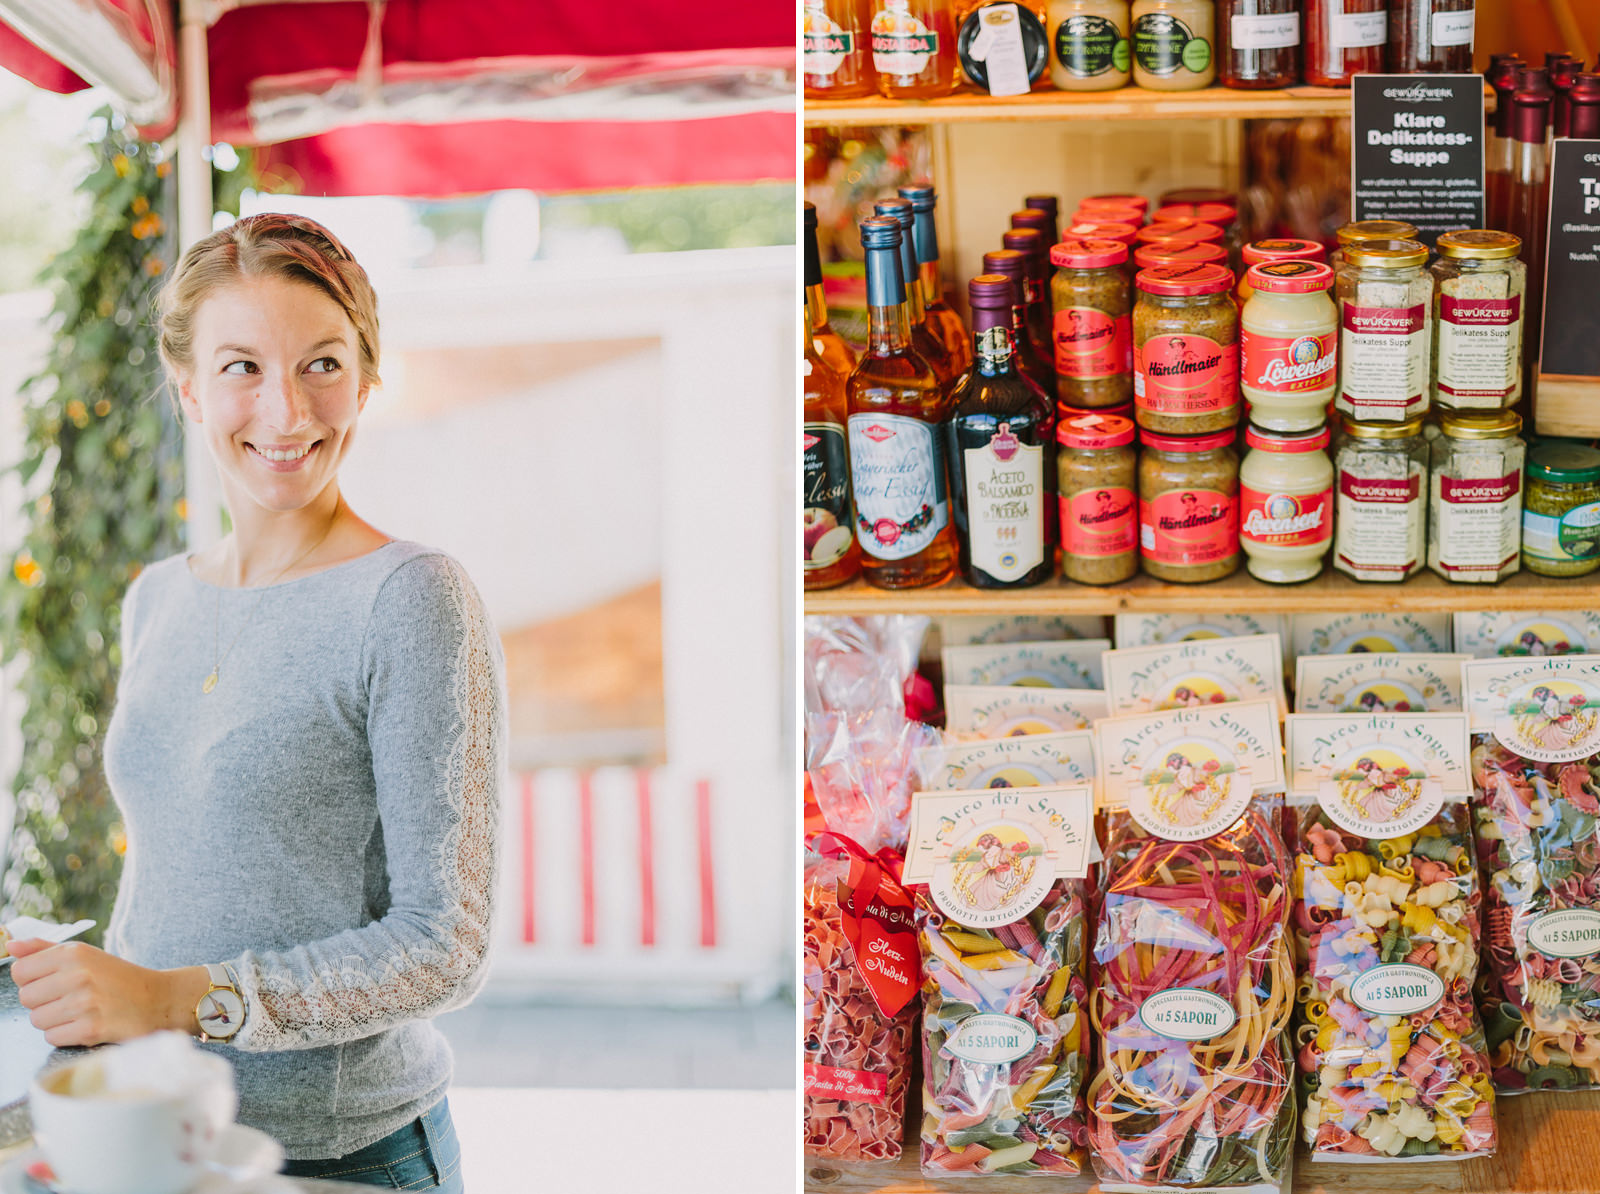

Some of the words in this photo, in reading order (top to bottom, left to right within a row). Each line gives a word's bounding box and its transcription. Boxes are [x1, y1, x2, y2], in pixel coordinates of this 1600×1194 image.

[1394, 112, 1446, 128] Klare
[1367, 130, 1473, 145] Delikatess-
[1390, 148, 1450, 167] Suppe
[1149, 354, 1222, 377] Händlmaier
[991, 468, 1025, 484] ACETO
[978, 482, 1034, 499] BALSAMICO
[1544, 659, 1573, 670] dei
[1173, 711, 1200, 723] dei
[1209, 713, 1271, 760] Sapori
[1368, 716, 1395, 729] dei
[1404, 723, 1463, 772] Sapori
[992, 791, 1020, 806] dei
[1138, 812, 1183, 837] PRODOTTI
[1328, 803, 1373, 833] PRODOTTI
[1377, 801, 1435, 833] ARTIGIANALI
[937, 889, 978, 922] PRODOTTI
[982, 886, 1044, 923] ARTIGIANALI
[1553, 931, 1559, 943] 5
[868, 938, 905, 961] Herz-
[865, 957, 909, 985] Nudeln
[1376, 987, 1382, 1000] 5
[1384, 985, 1428, 999] SAPORI
[1166, 1010, 1172, 1022] 5
[1174, 1010, 1217, 1026] SAPORI
[968, 1035, 974, 1048] 5
[976, 1035, 1019, 1048] SAPORI
[833, 1069, 856, 1083] 500g
